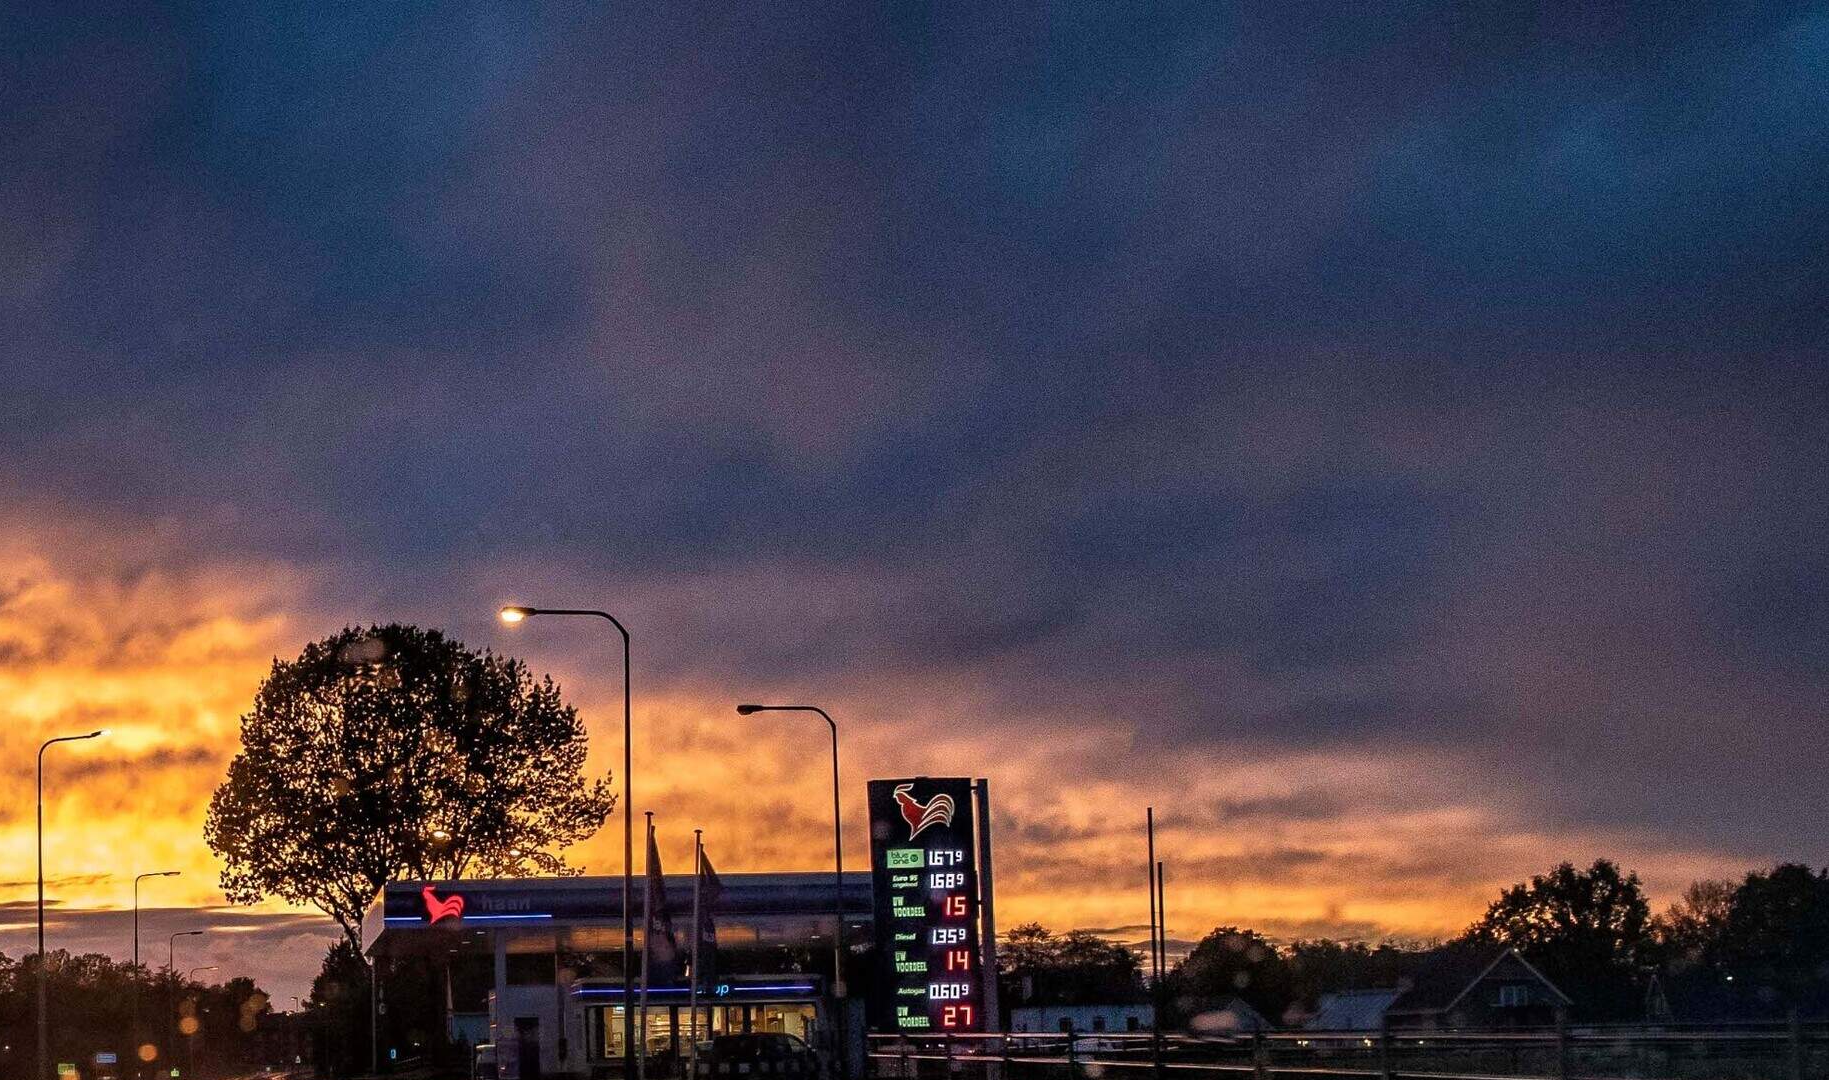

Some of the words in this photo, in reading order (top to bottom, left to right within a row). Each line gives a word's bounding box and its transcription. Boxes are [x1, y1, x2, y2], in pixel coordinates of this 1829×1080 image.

[892, 874, 909, 882] Euro
[909, 874, 918, 882] 95
[892, 896, 904, 906] UW
[945, 896, 966, 916] 15
[893, 906, 926, 917] VOORDEEL
[895, 932, 917, 941] Diesel
[895, 951, 906, 961] UW
[947, 950, 969, 971] 14
[896, 961, 928, 972] VOORDEEL
[897, 987, 926, 996] Autogas
[897, 1006, 908, 1016] UW
[944, 1005, 971, 1026] 27
[898, 1016, 930, 1027] VOORDEEL
